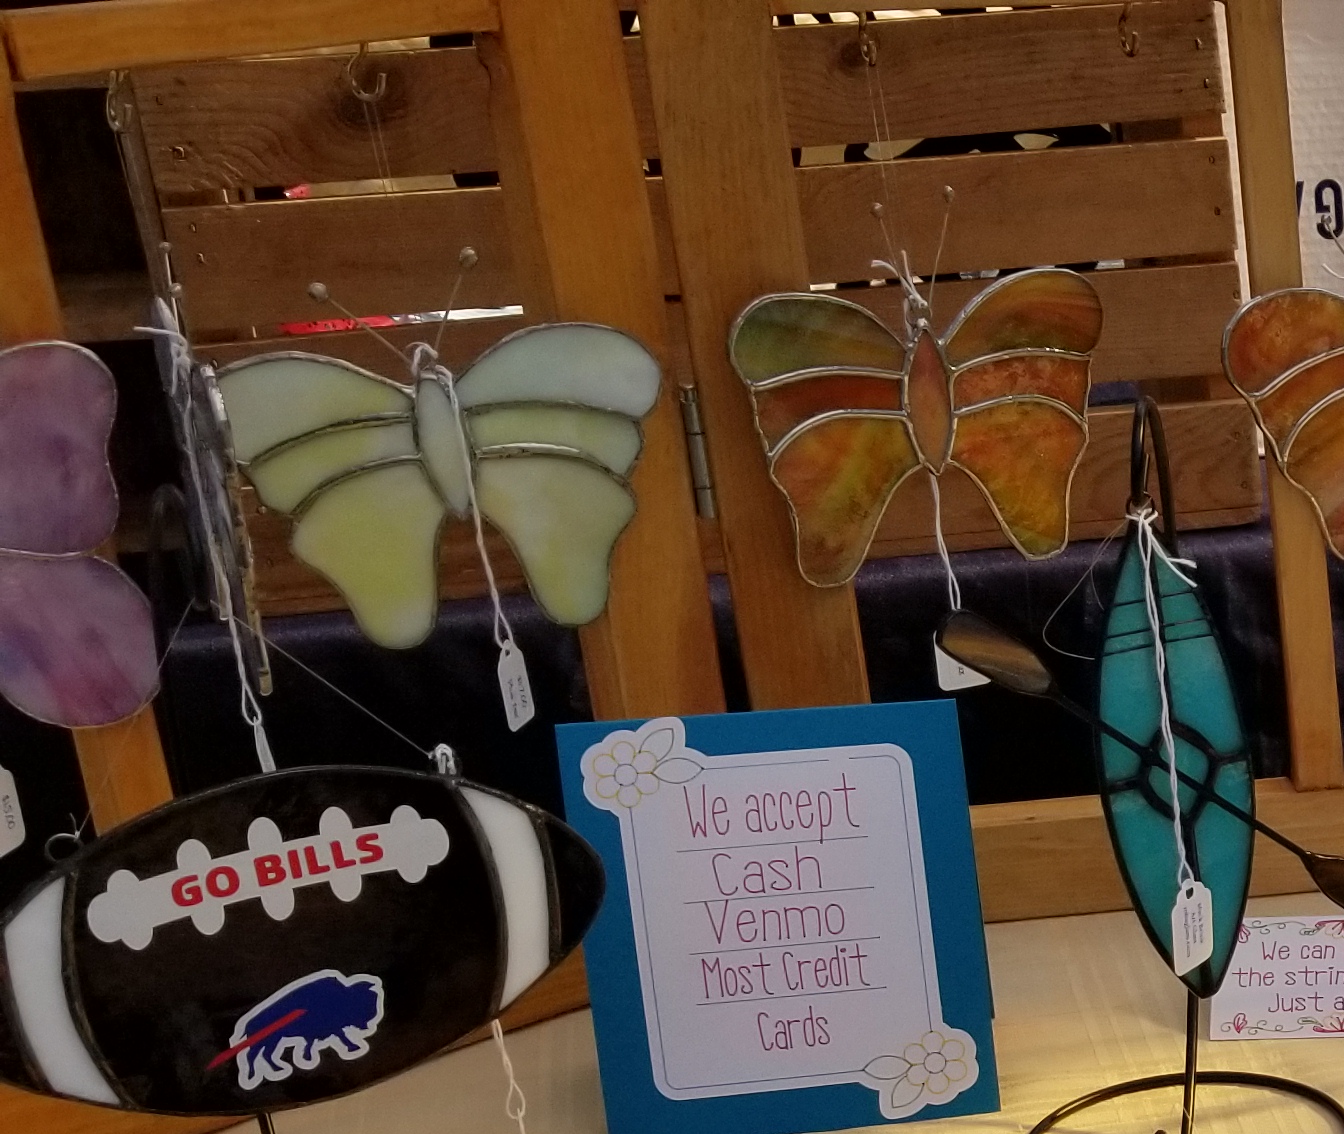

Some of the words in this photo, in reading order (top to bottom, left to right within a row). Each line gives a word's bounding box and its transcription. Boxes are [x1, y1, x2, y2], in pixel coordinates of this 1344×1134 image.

[684, 783, 730, 838] We
[745, 772, 860, 844] accept
[171, 866, 240, 907] GO
[253, 832, 384, 887] BILLS
[711, 846, 822, 896] Cash
[703, 899, 845, 944] Venmo
[701, 950, 774, 999] Most
[782, 944, 871, 991] Credit
[1262, 940, 1290, 961] We
[1300, 942, 1335, 960] can
[1232, 967, 1275, 988] the
[1268, 992, 1324, 1013] Just
[757, 1006, 831, 1051] Cards
